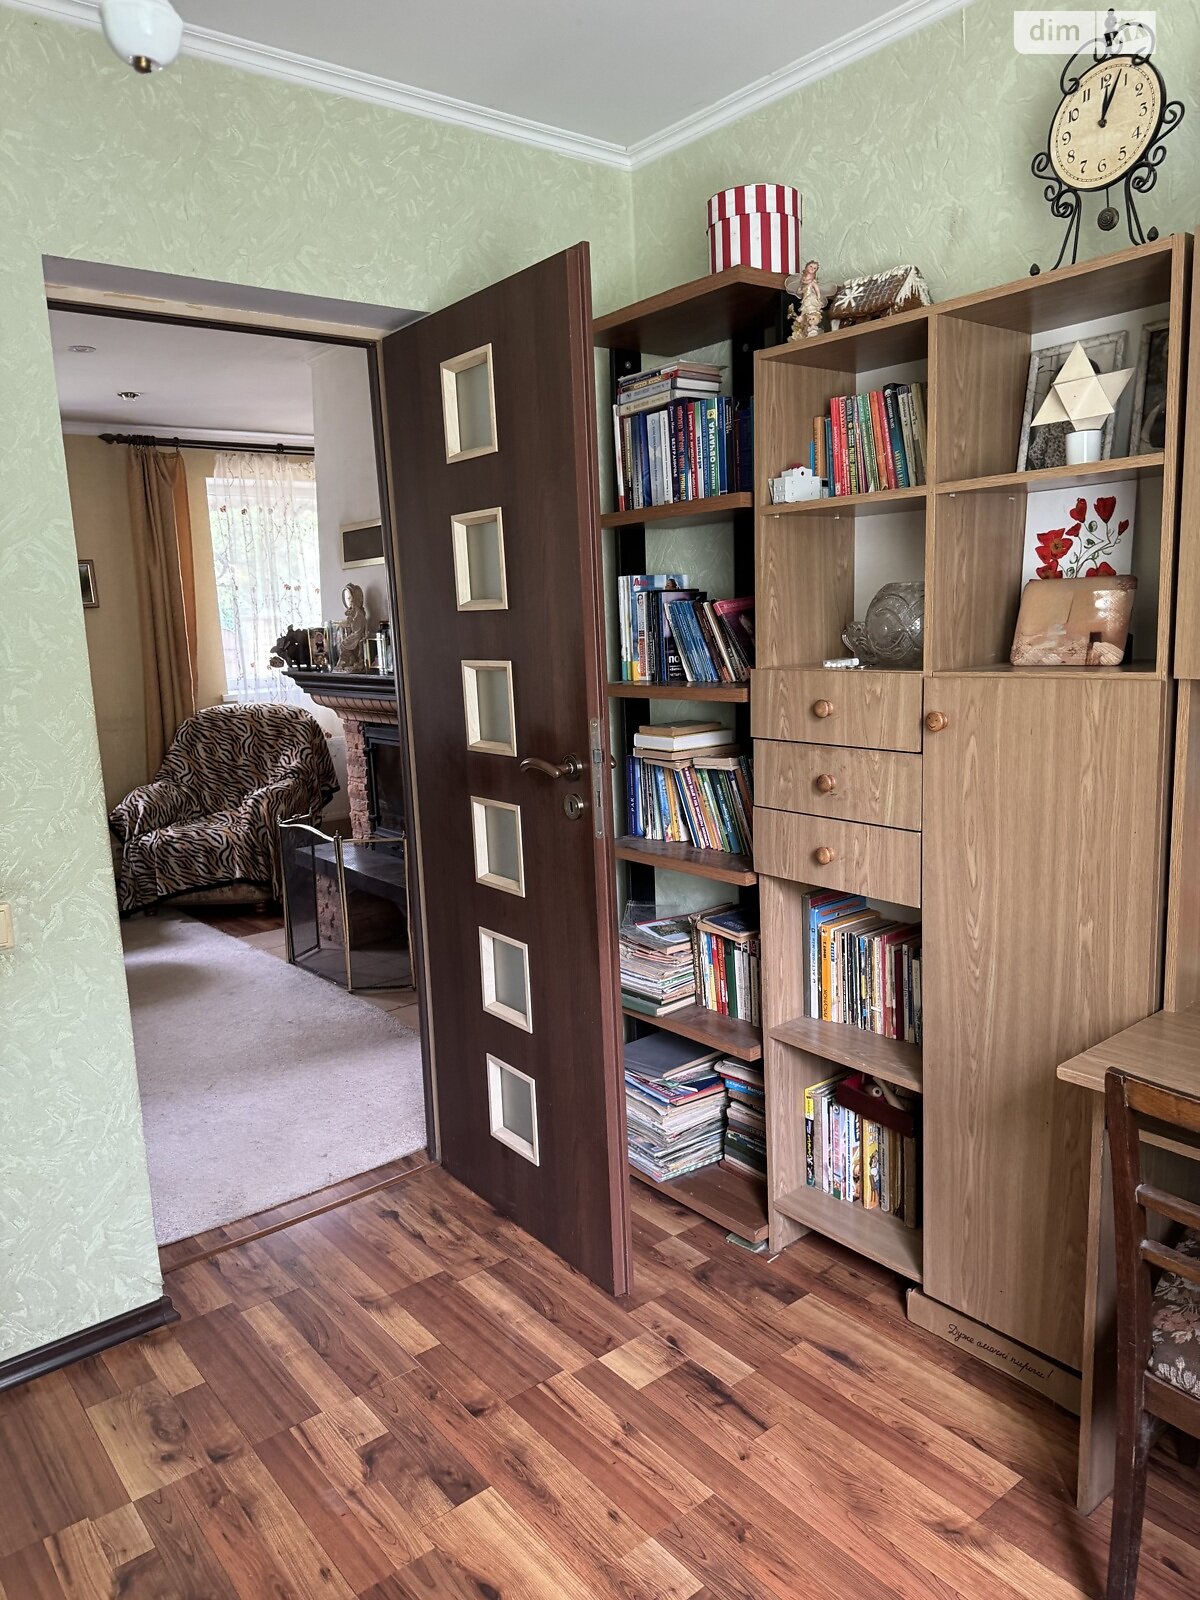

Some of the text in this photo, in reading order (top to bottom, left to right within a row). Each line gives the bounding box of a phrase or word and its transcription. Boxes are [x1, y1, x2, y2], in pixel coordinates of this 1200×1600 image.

[1082, 88, 1091, 103] 11
[1135, 83, 1143, 97] 2
[1068, 108, 1080, 123] 10
[1139, 102, 1148, 117] 3
[1062, 131, 1071, 145] 9
[1131, 126, 1142, 139] 4
[1067, 150, 1075, 163] 8
[1118, 146, 1126, 161] 5
[1080, 160, 1087, 174] 7
[1098, 159, 1107, 172] 6
[948, 1323, 975, 1344] Дуже
